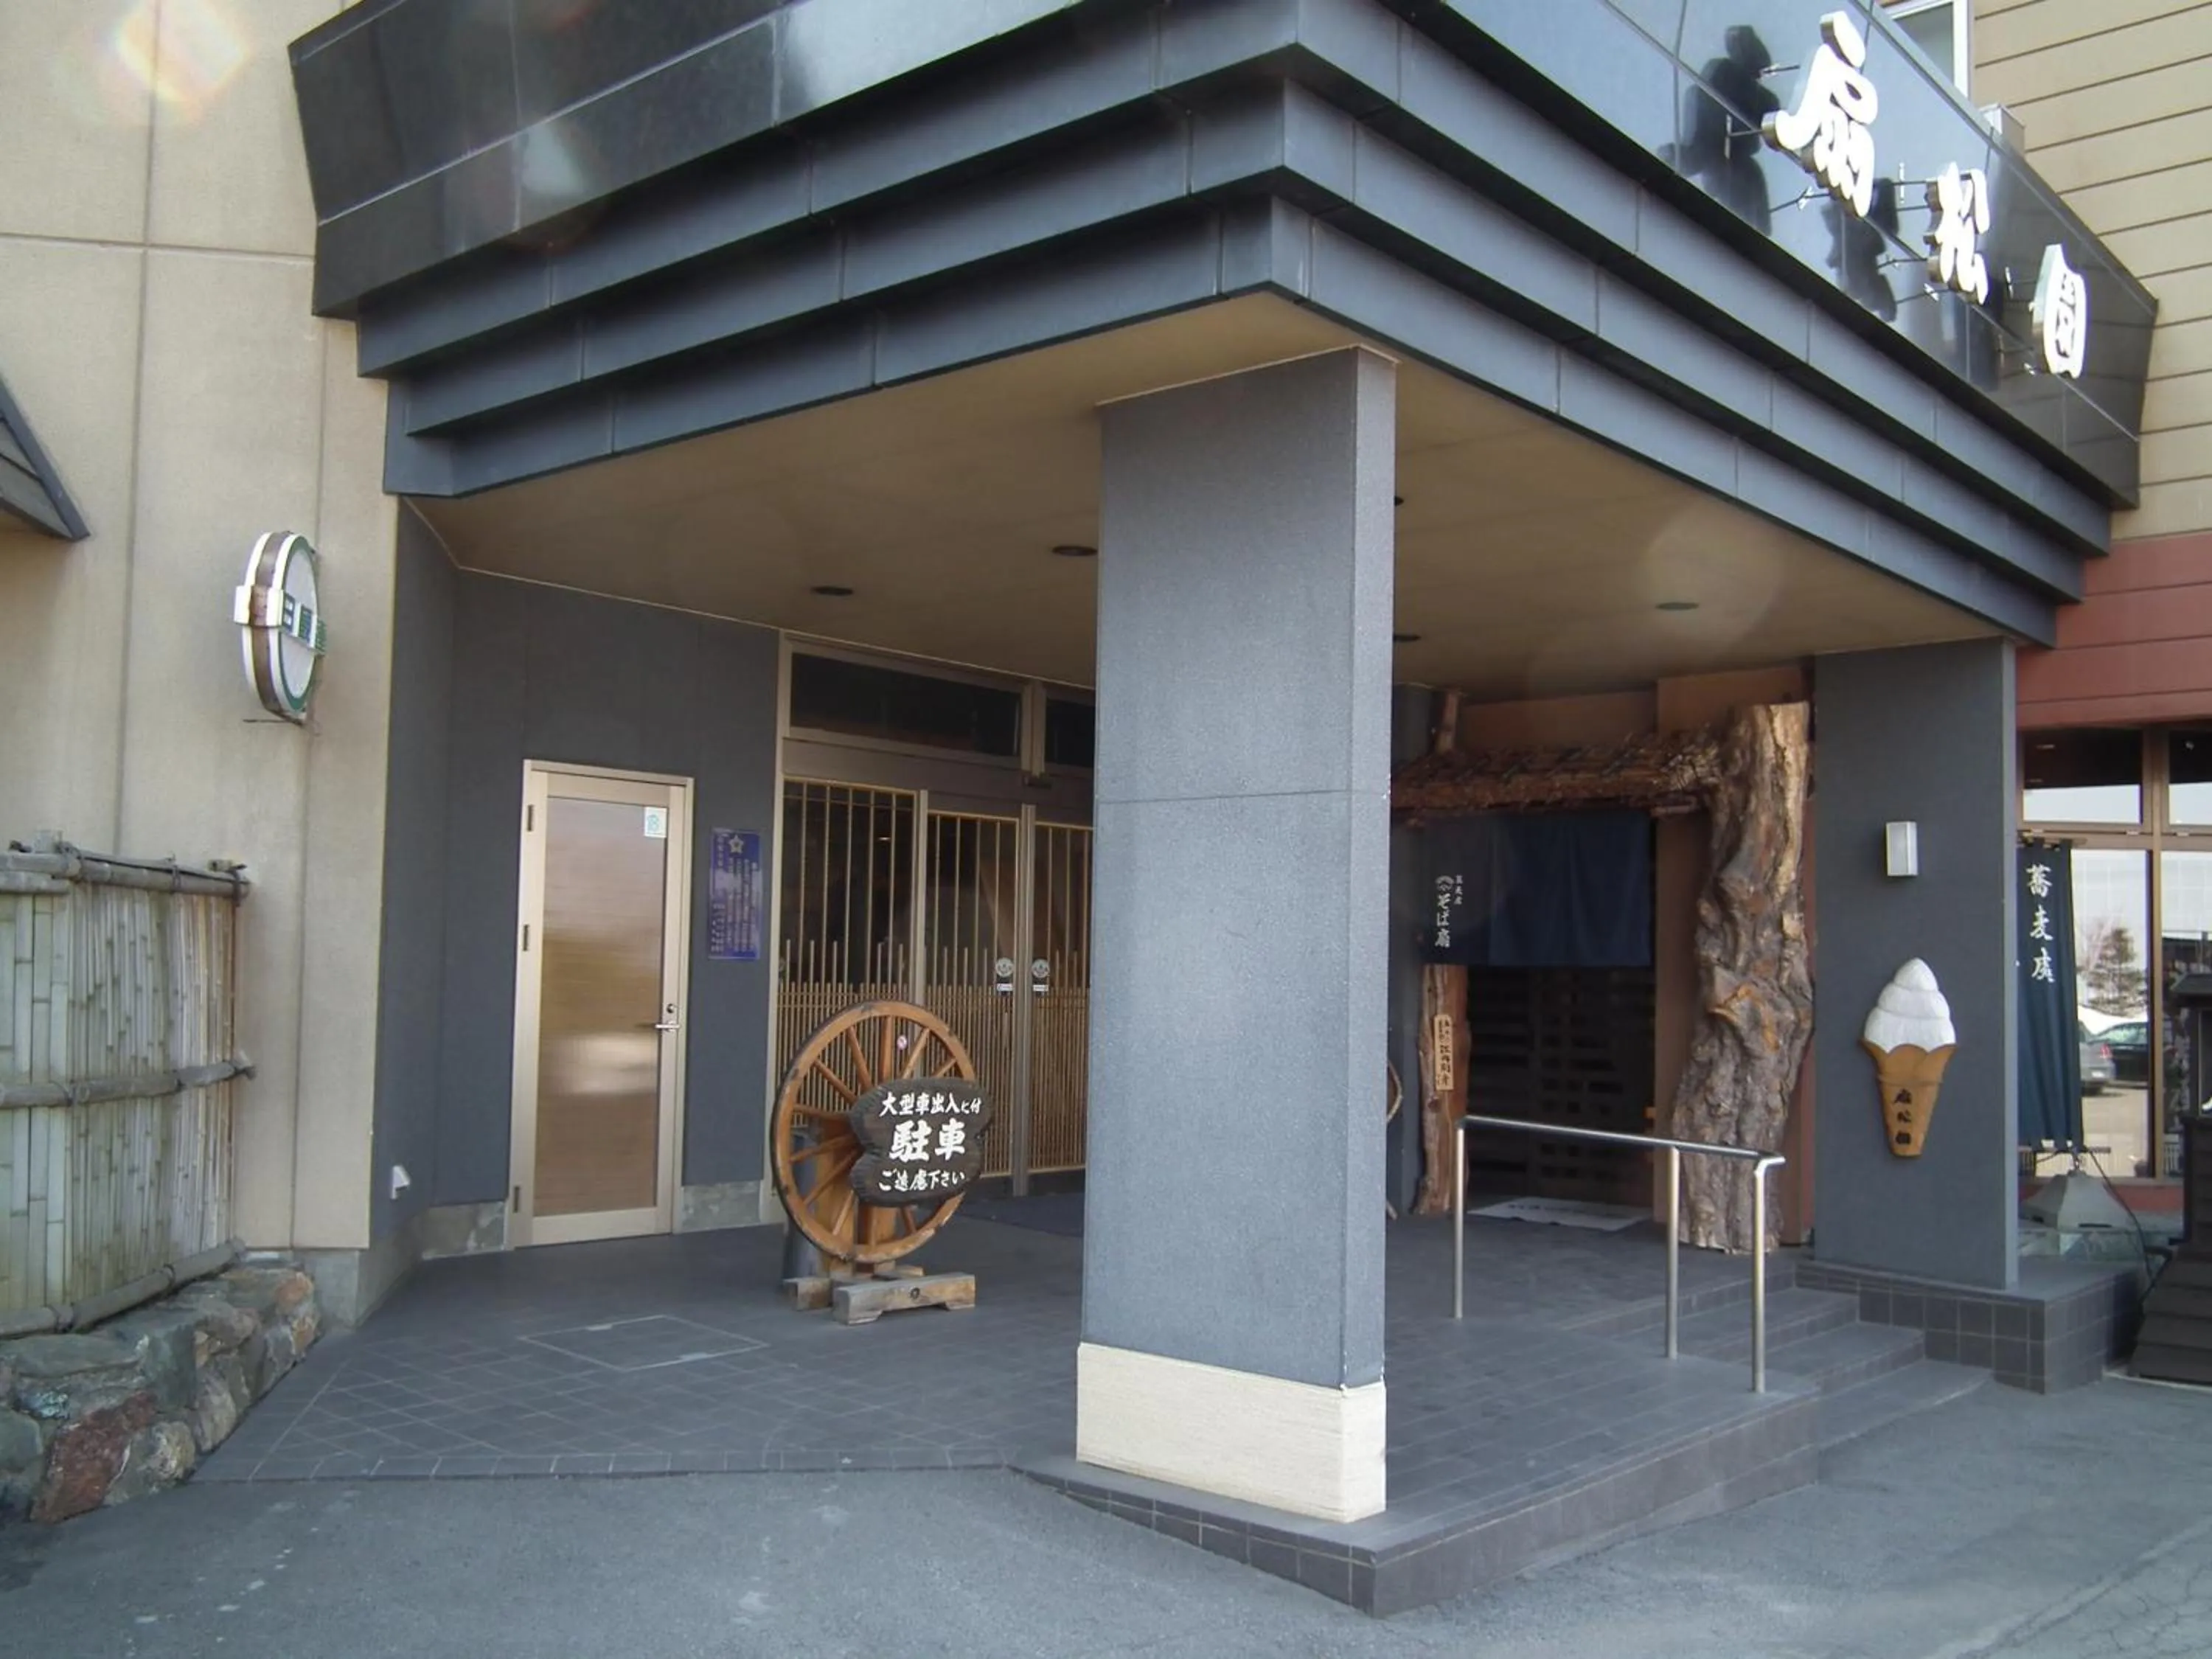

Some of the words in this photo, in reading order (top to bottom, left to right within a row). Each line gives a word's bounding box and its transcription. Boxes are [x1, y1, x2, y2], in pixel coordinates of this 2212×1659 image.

[888, 1117, 966, 1163] 駐車
[878, 1167, 965, 1192] ご遠慮下さい
